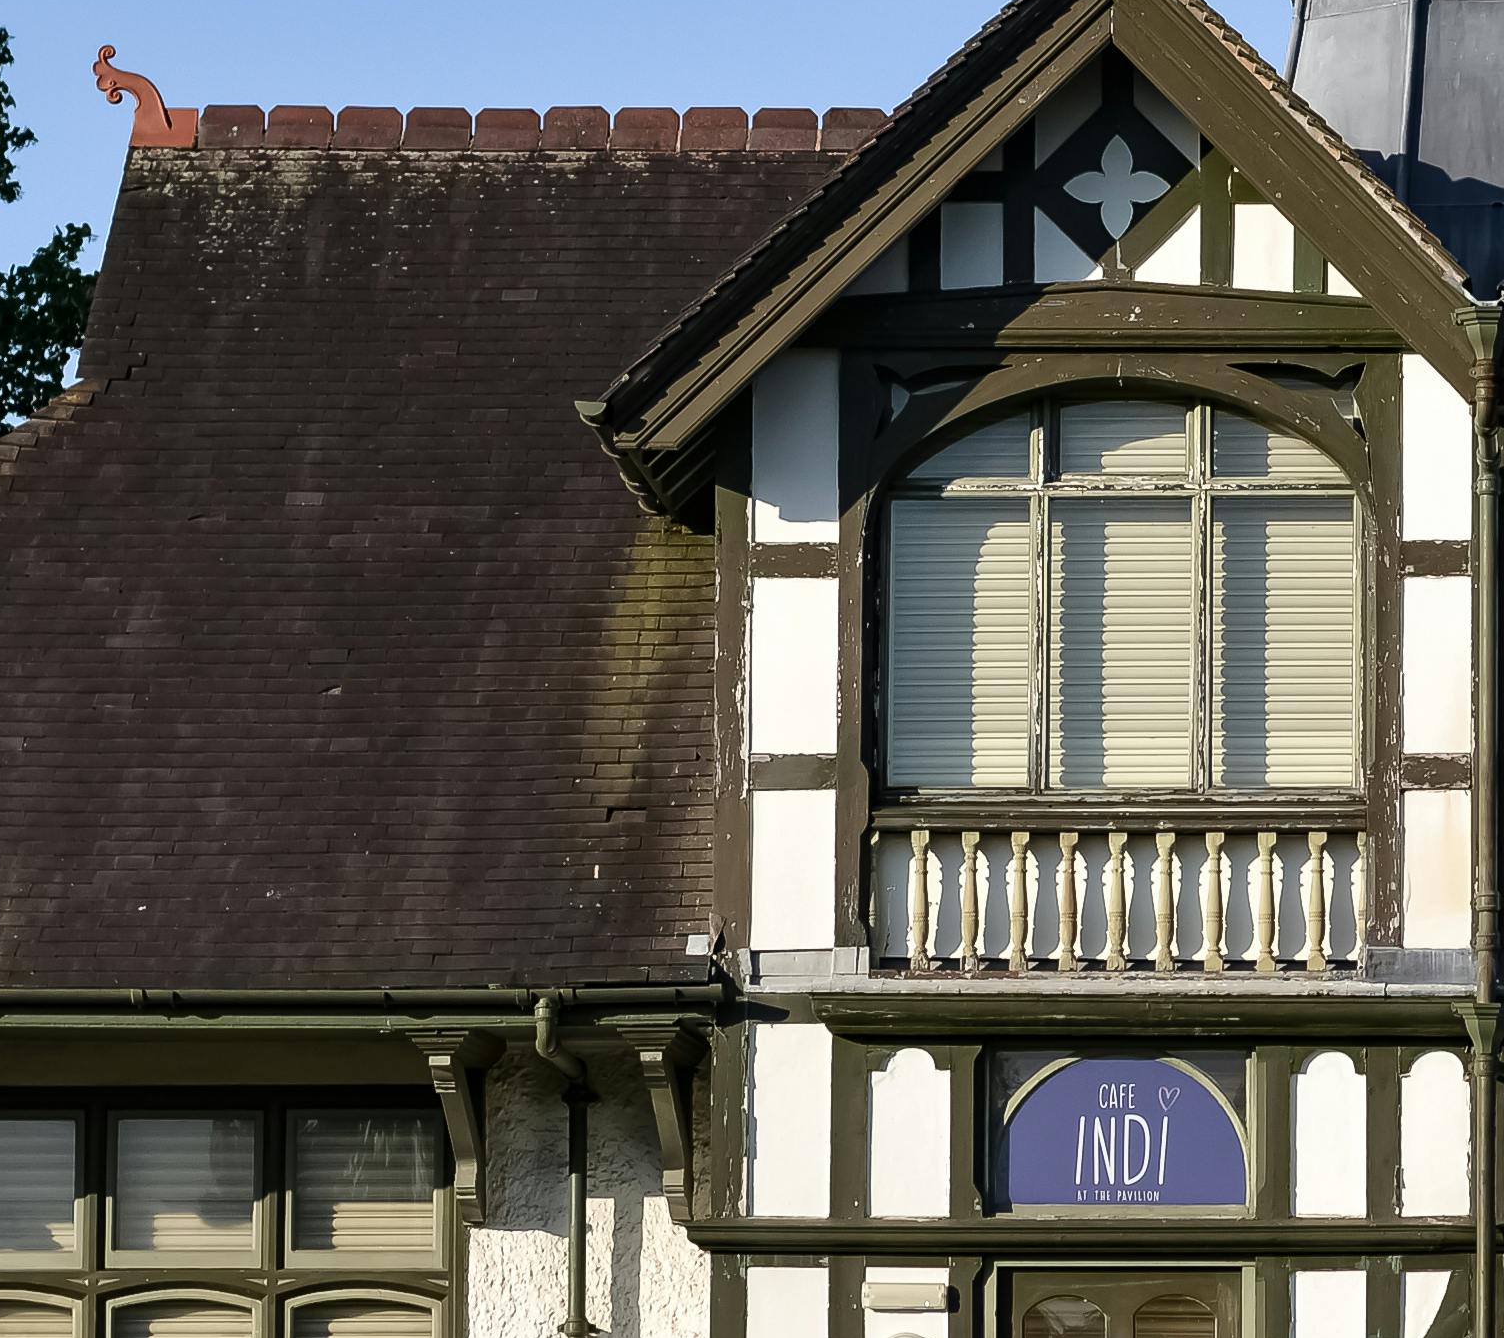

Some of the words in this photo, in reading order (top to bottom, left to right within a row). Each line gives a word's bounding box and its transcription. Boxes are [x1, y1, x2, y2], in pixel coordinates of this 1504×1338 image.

[1099, 1083, 1136, 1109] CAFE
[1075, 1114, 1169, 1186] INDI
[1077, 1190, 1088, 1202] AT
[1095, 1190, 1111, 1201] THE
[1117, 1190, 1160, 1202] PAVILION
